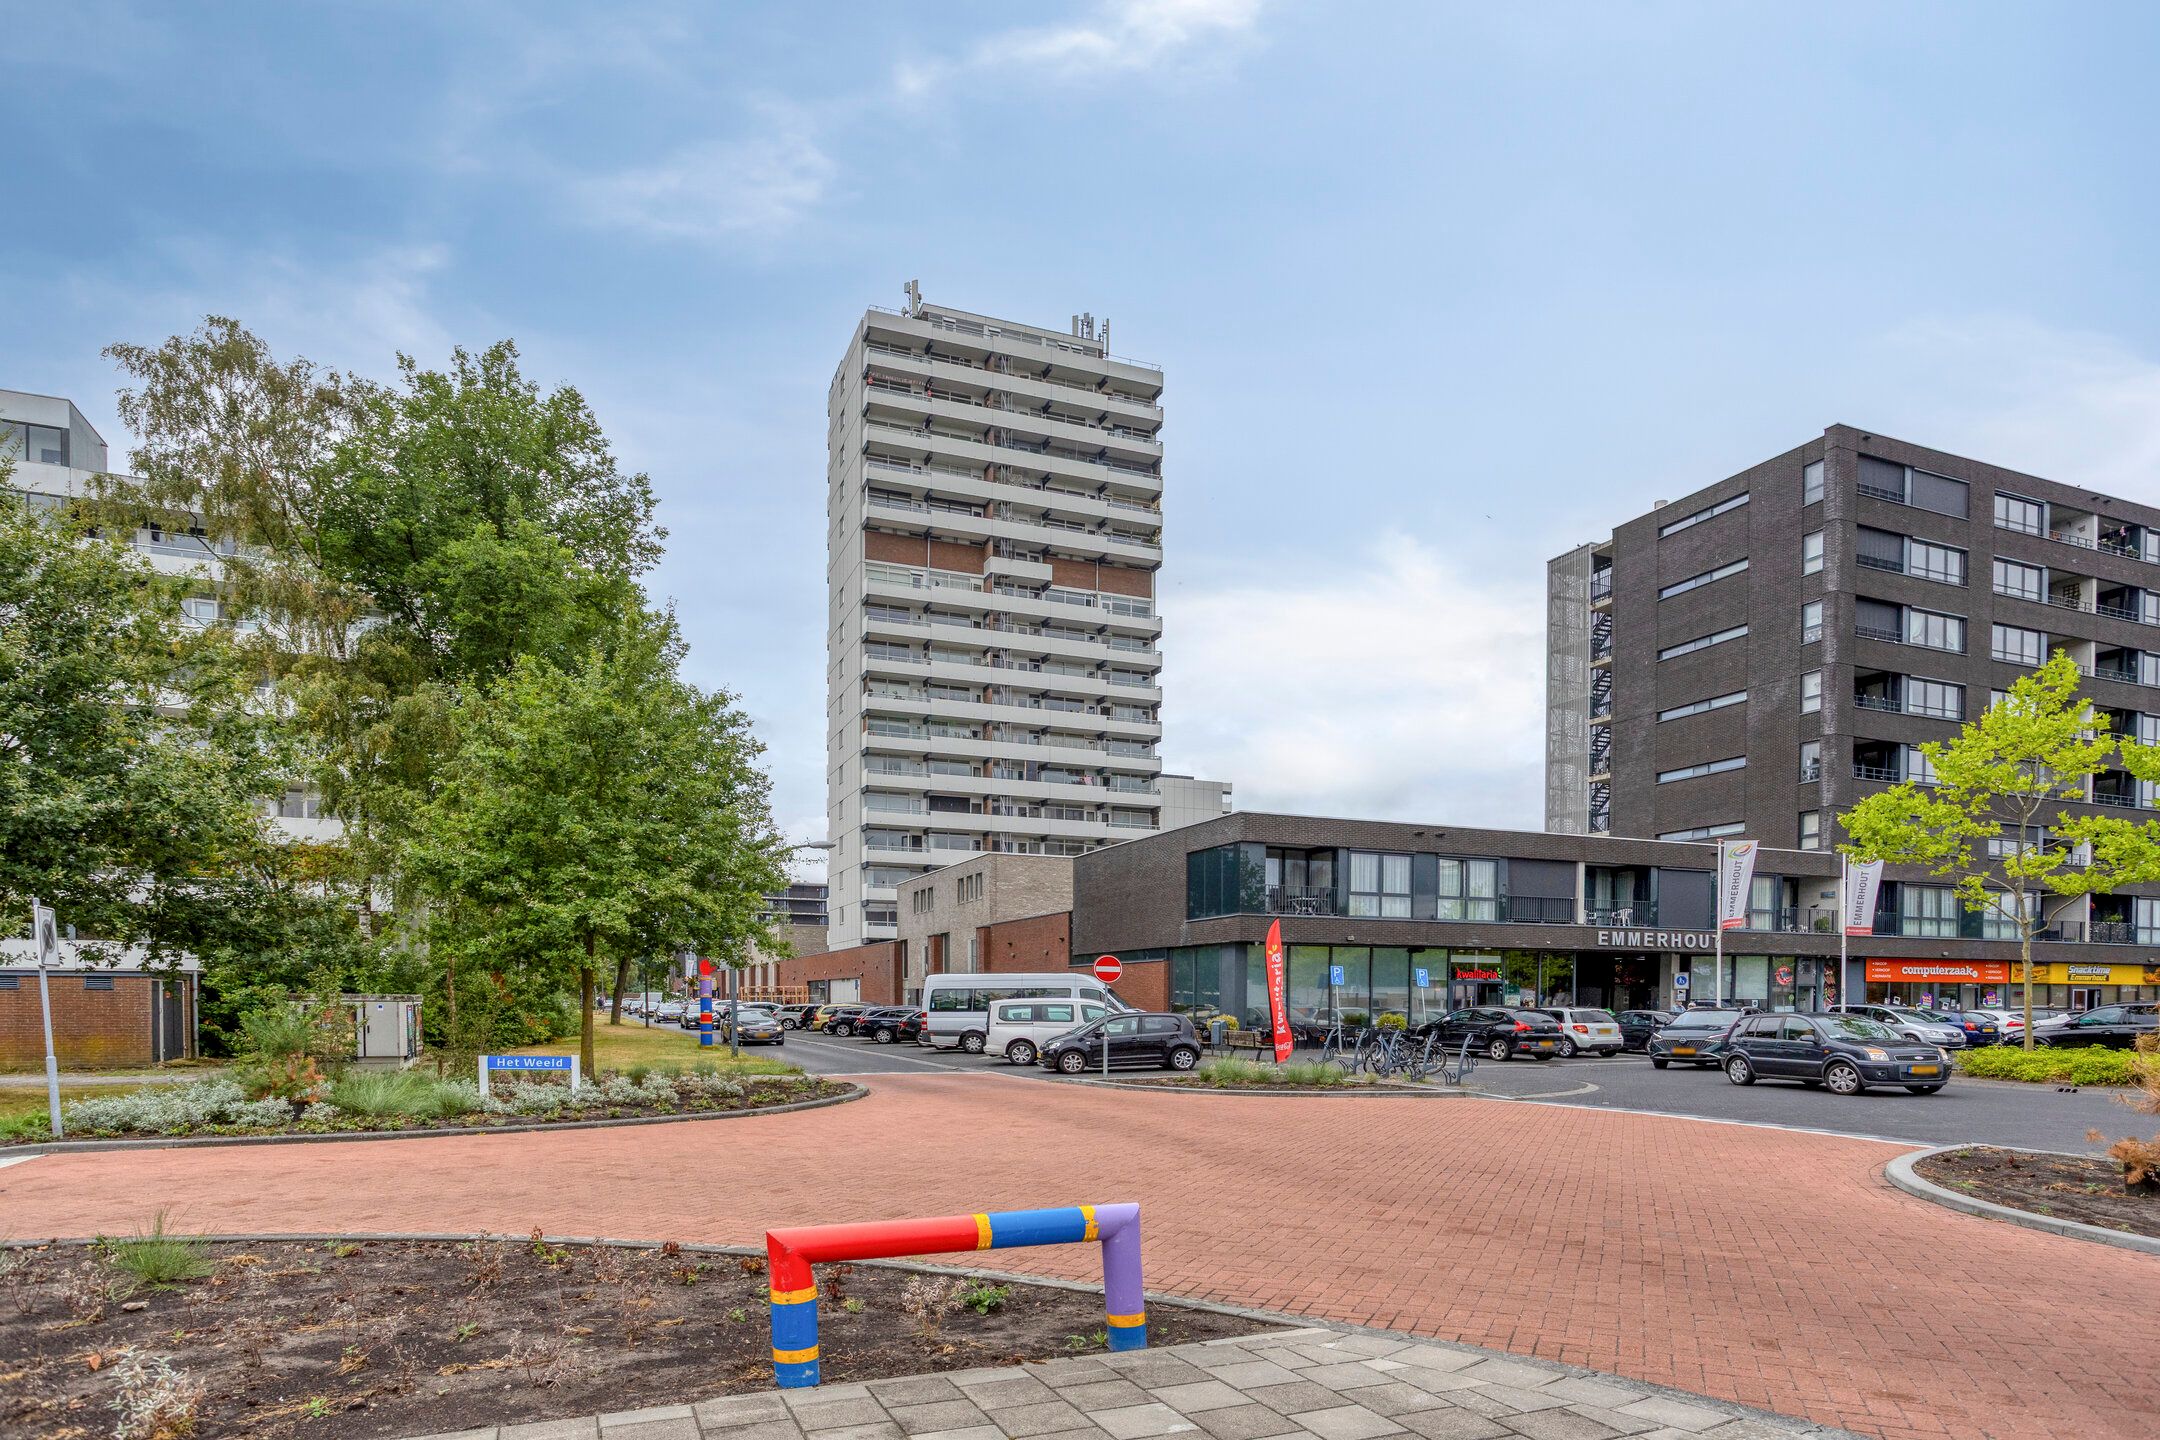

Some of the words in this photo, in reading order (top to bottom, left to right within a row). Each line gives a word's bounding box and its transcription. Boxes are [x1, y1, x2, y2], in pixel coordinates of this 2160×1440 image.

[1853, 871, 1870, 926] EMMERHOUT
[1455, 967, 1498, 979] kwalitaria
[1901, 965, 1973, 978] computerzaak
[496, 1057, 520, 1067] Het
[523, 1057, 563, 1067] Weeld
